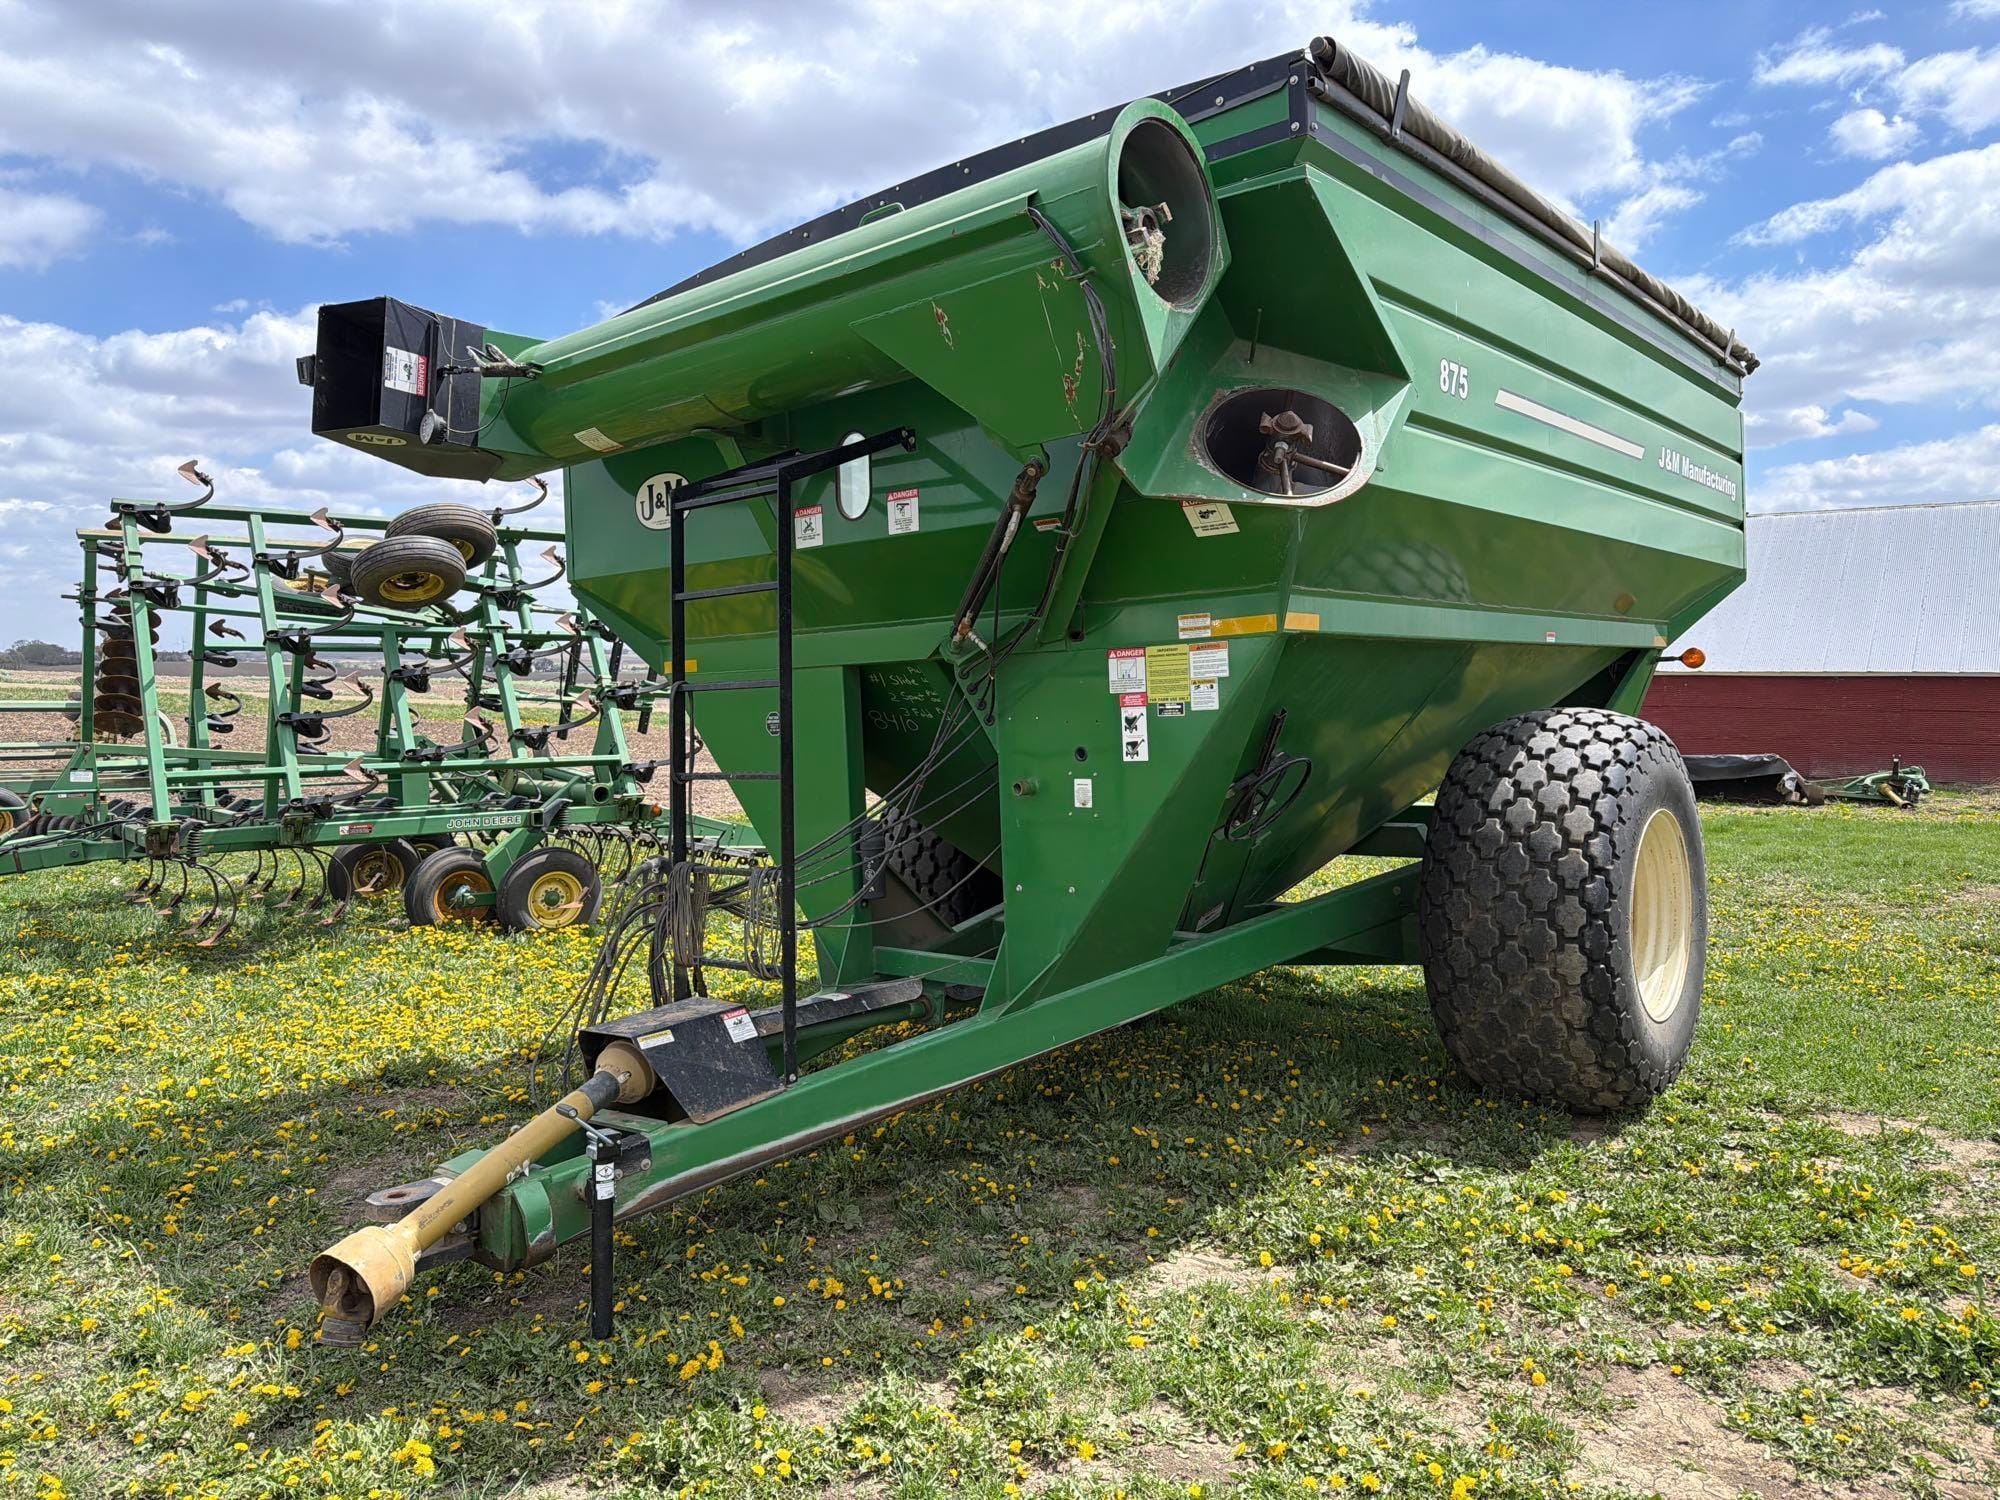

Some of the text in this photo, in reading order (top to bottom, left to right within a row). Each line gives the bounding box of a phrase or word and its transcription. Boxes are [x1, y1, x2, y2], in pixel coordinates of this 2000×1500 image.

[417, 363, 426, 395] DANGER
[1439, 358, 1469, 400] 875
[1658, 446, 1736, 501] J&M Manufacturing
[893, 489, 918, 499] DANGER
[800, 506, 822, 516] DANGER
[1116, 649, 1145, 657] DANGER
[868, 709, 919, 733] 8410
[447, 815, 522, 829] JOHN DEERE
